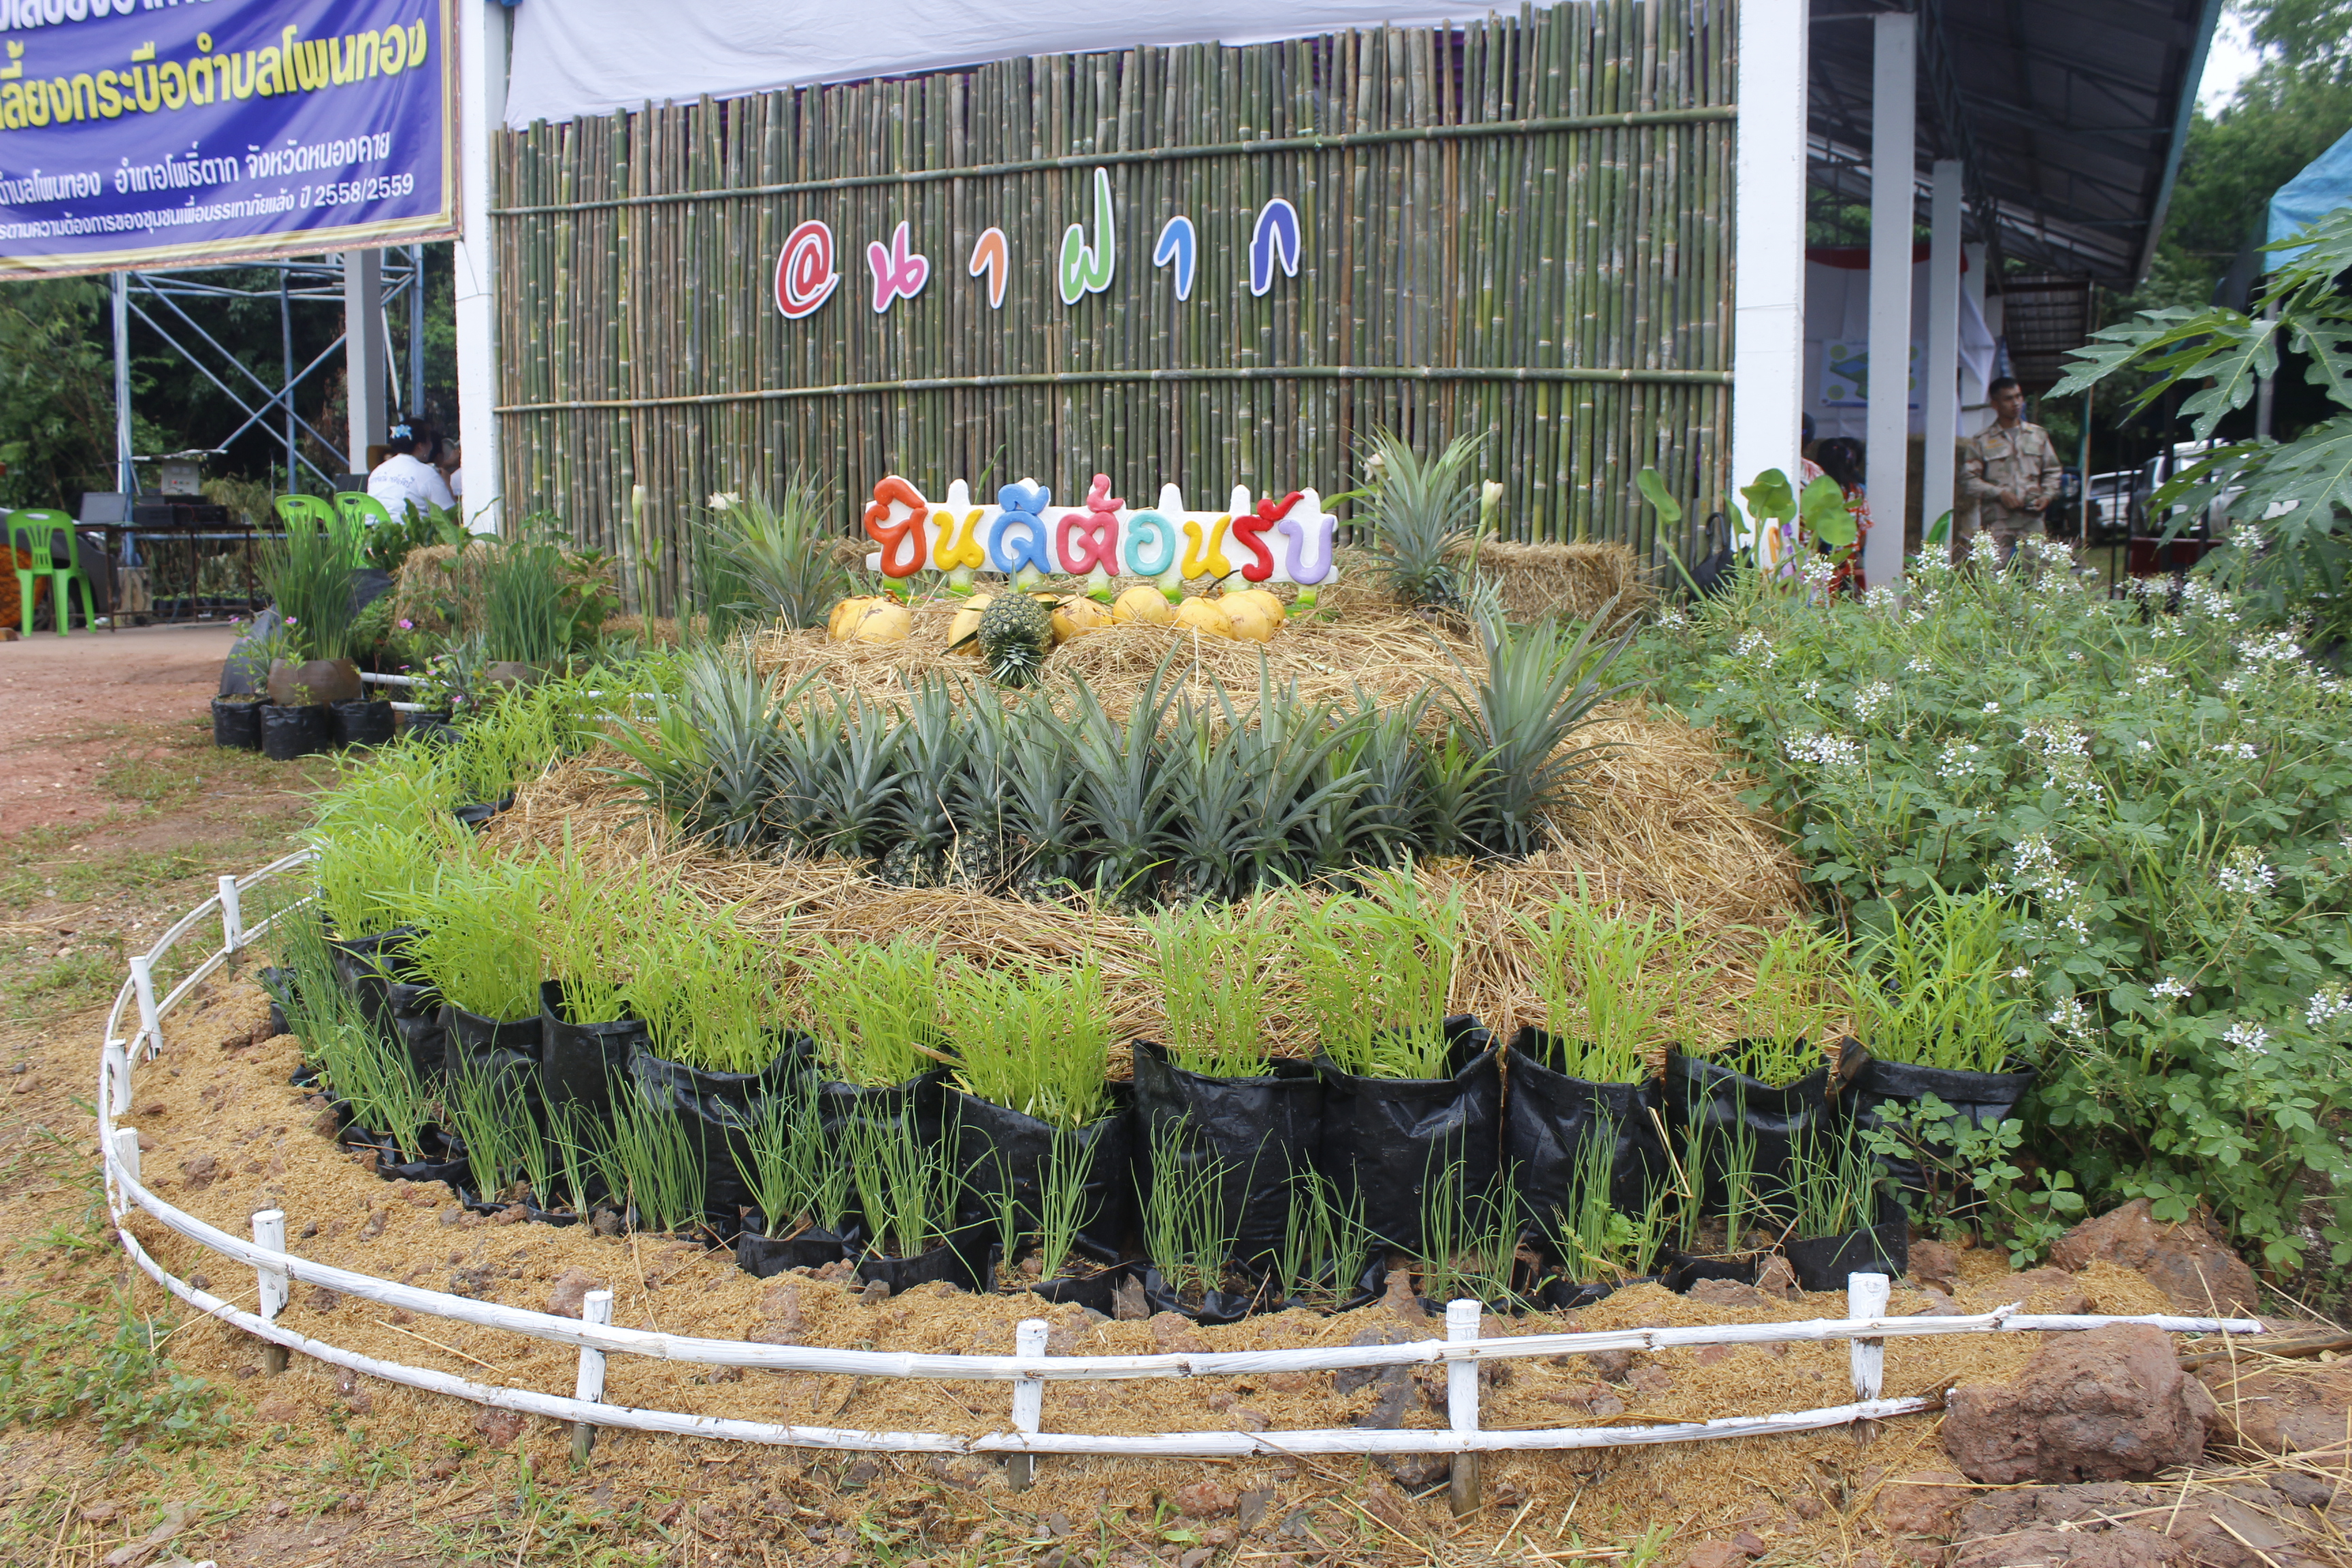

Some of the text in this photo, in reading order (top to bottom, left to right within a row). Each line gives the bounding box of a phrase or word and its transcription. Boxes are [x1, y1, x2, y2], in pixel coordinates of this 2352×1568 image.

[245, 131, 391, 180] จังหวัดหนองคาย
[314, 172, 414, 208] 2558/2559
[863, 473, 1335, 585] ยินดีต้อนรับ
